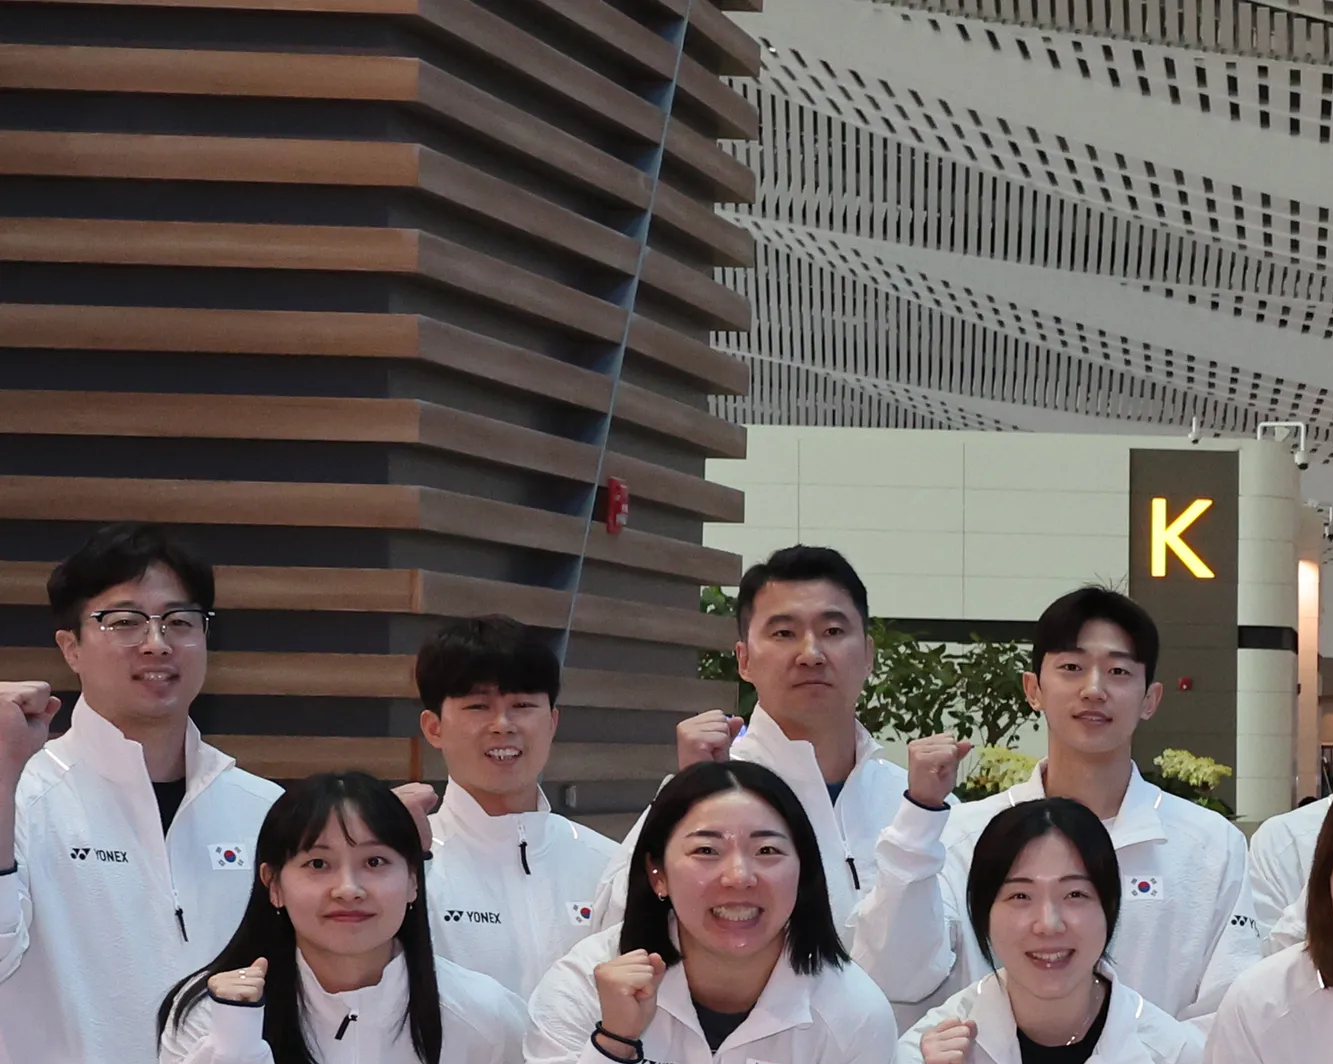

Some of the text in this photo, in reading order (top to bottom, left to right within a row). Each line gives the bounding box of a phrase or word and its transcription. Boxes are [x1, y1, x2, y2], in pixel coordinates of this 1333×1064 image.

[1151, 498, 1216, 579] K
[95, 850, 129, 863] YONEX
[466, 911, 502, 924] YONEX
